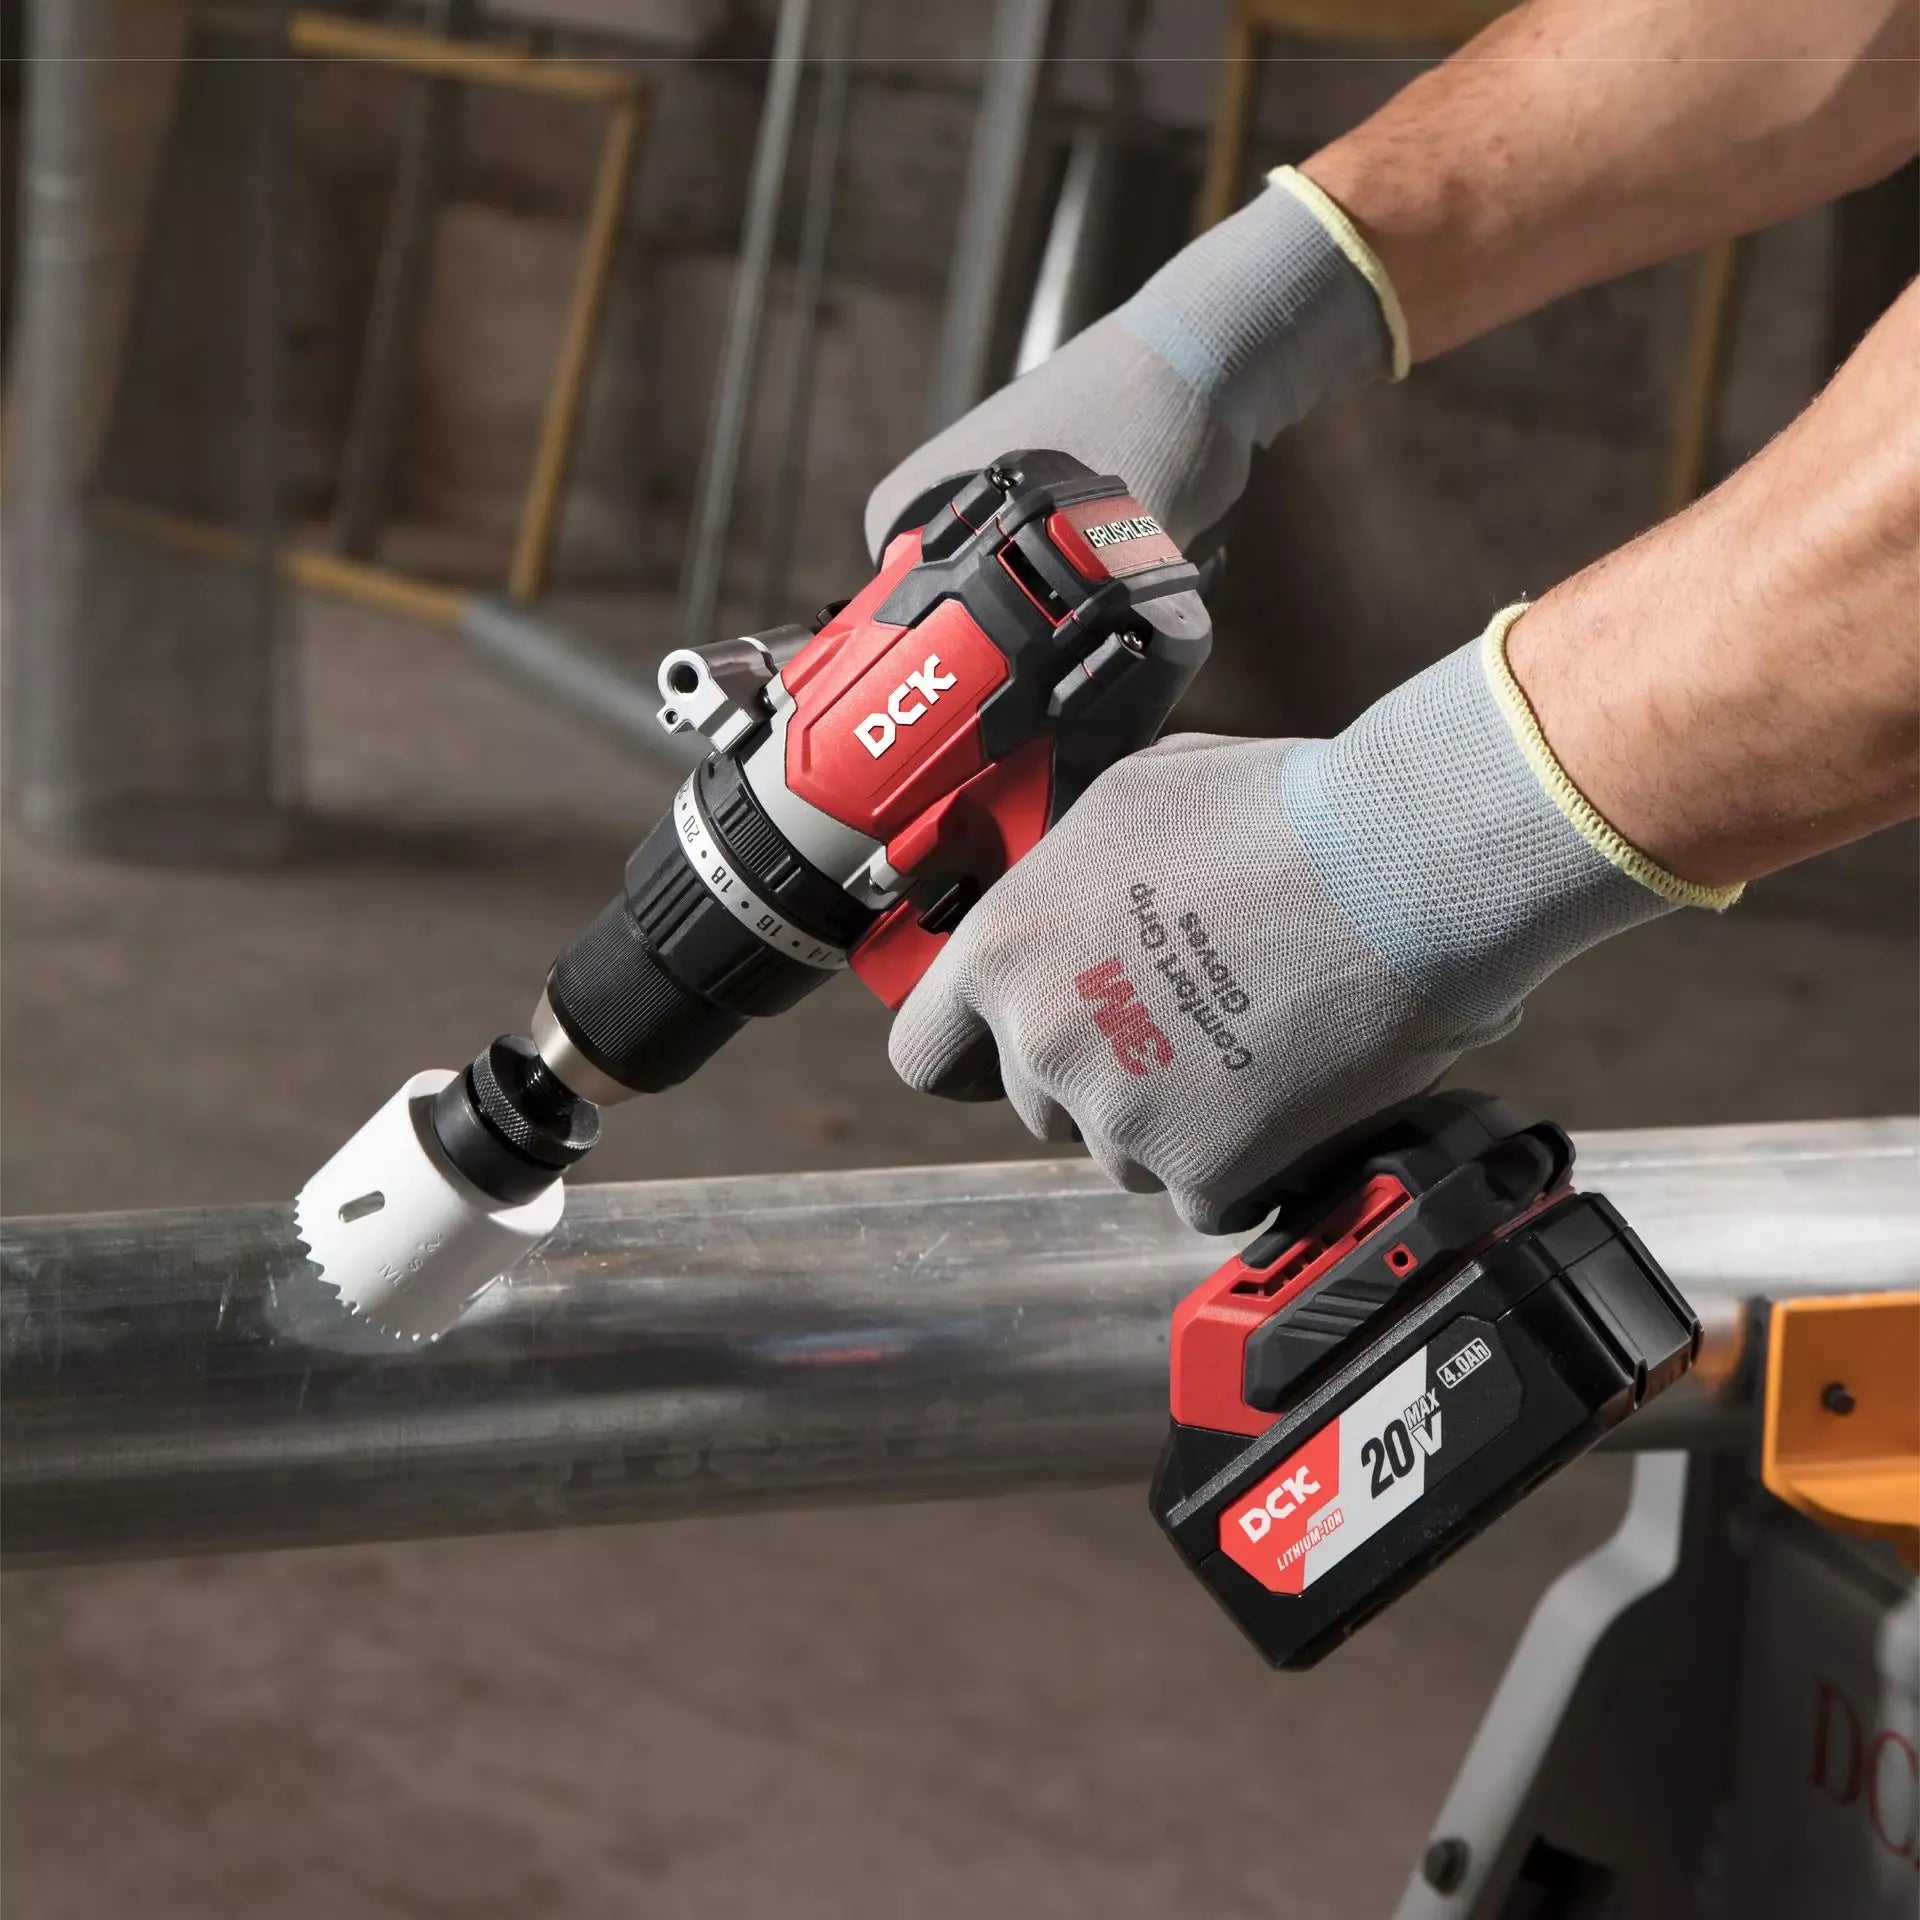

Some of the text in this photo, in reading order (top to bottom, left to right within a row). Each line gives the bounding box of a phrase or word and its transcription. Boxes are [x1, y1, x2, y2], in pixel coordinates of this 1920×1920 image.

[1084, 515, 1162, 549] BRUSHLESS
[853, 653, 957, 759] DCK
[682, 815, 833, 963] 14 16 18 20
[1129, 882, 1251, 1071] Comfort Grip
[1178, 911, 1250, 1014] Gloves
[1073, 958, 1175, 1078] 3M
[1441, 1338, 1490, 1386] 4.0Ah
[1403, 1387, 1441, 1430] MAX
[1360, 1410, 1442, 1500] 20 V
[1238, 1465, 1321, 1543] DCK
[1276, 1508, 1344, 1571] LITHIUM-ION
